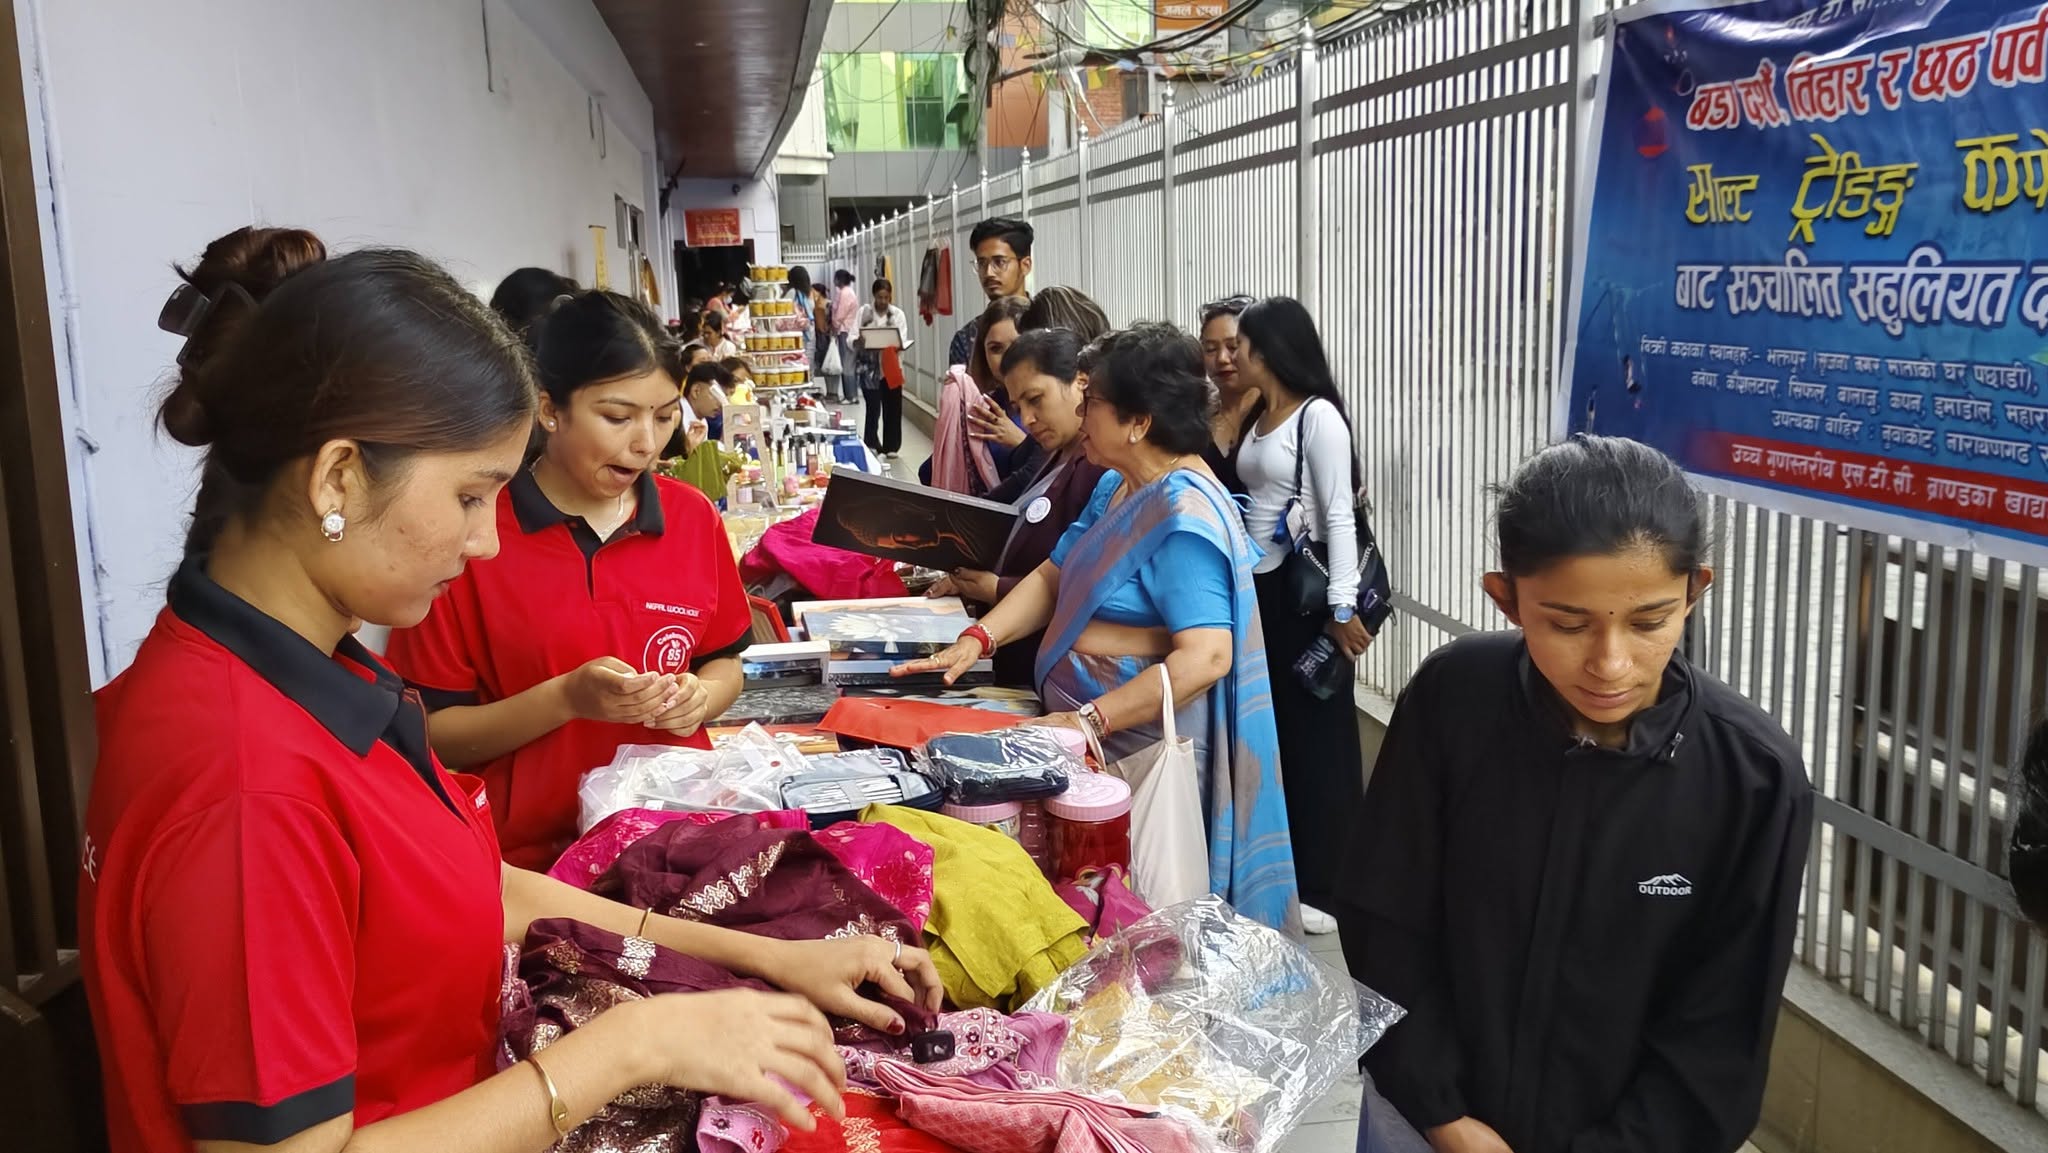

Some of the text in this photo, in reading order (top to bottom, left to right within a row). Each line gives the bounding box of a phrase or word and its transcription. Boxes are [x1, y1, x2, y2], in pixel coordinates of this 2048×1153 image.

[1878, 48, 1911, 109] र
[1910, 32, 1990, 101] छठ
[1676, 265, 1723, 309] बाट
[1726, 248, 1843, 318] सञ्चालित
[1849, 246, 2022, 336] सहुलियत
[1767, 348, 1807, 373] भक्तपुर
[1732, 444, 1763, 466] उच्च
[1766, 450, 1837, 480] गुणस्तरीय
[667, 649, 681, 661] 85
[1638, 884, 1692, 896] OUTDOOR
